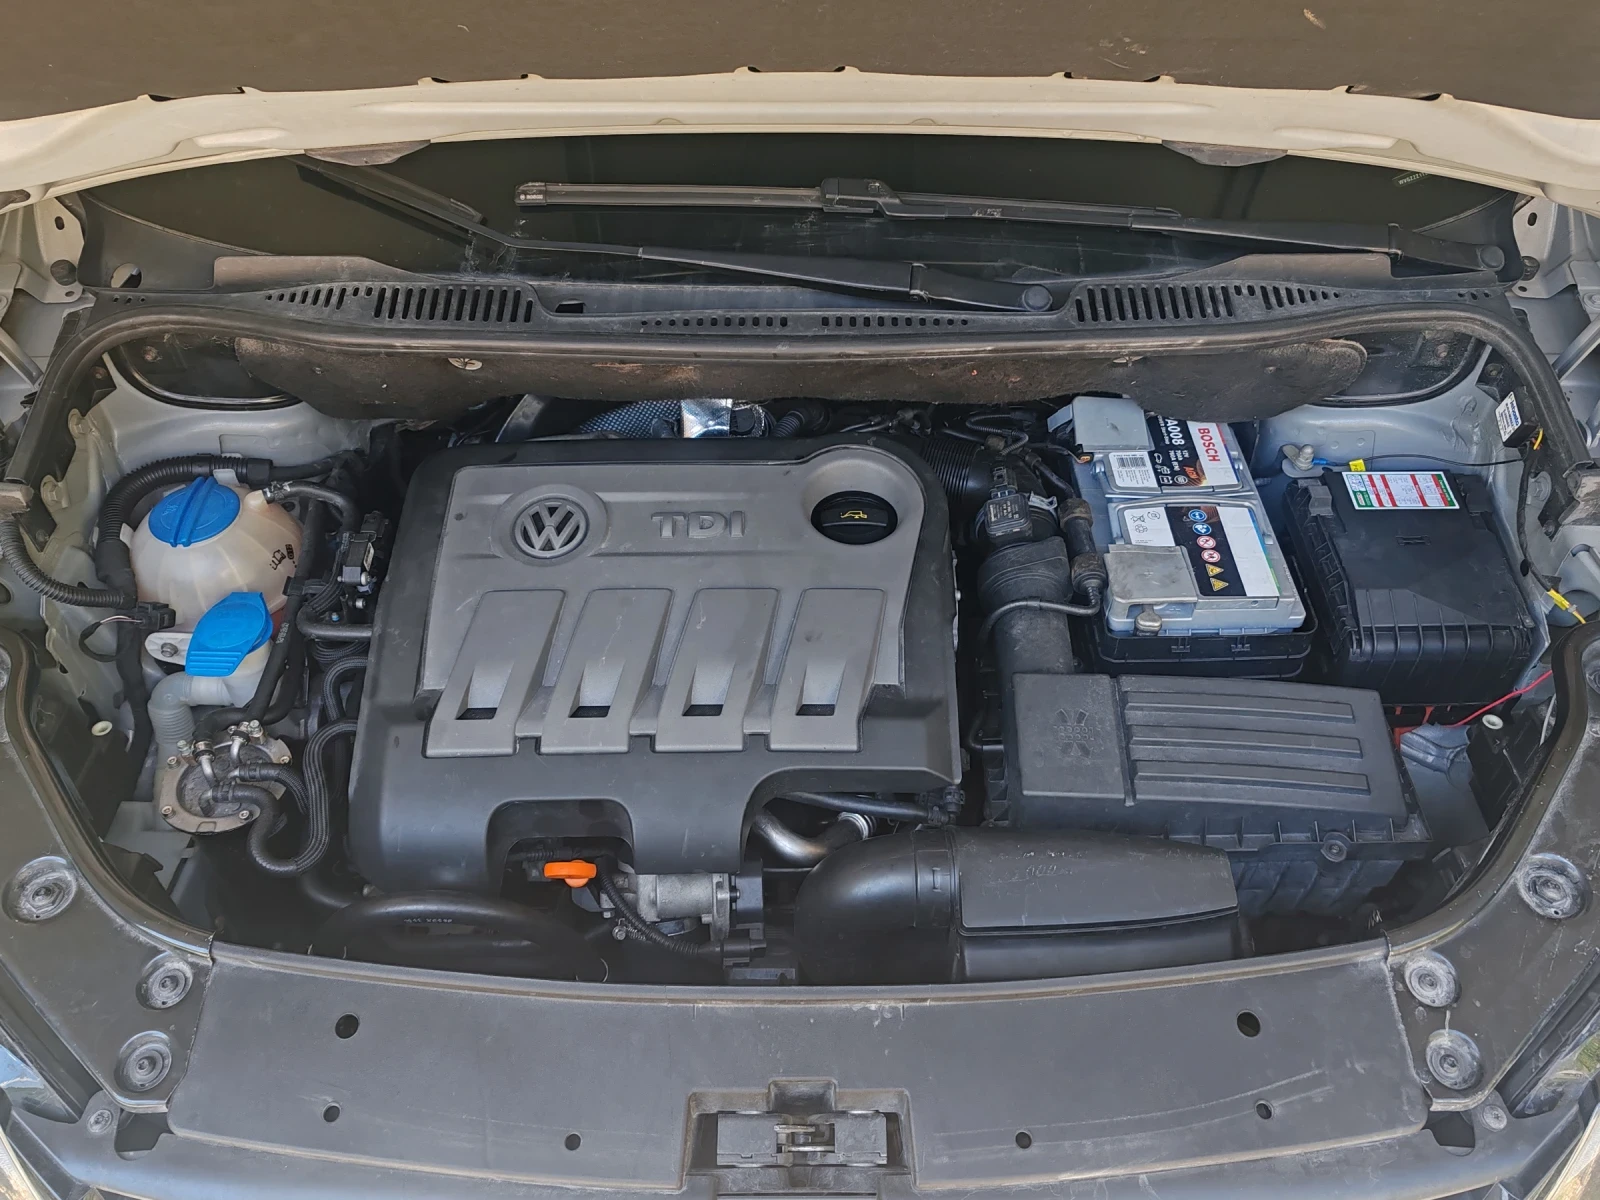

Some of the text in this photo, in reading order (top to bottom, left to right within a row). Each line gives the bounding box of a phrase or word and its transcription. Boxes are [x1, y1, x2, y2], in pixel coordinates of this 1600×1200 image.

[1165, 416, 1185, 446] A008
[1198, 428, 1221, 462] BOSCH
[1183, 466, 1199, 479] AGM
[651, 510, 745, 539] TDI
